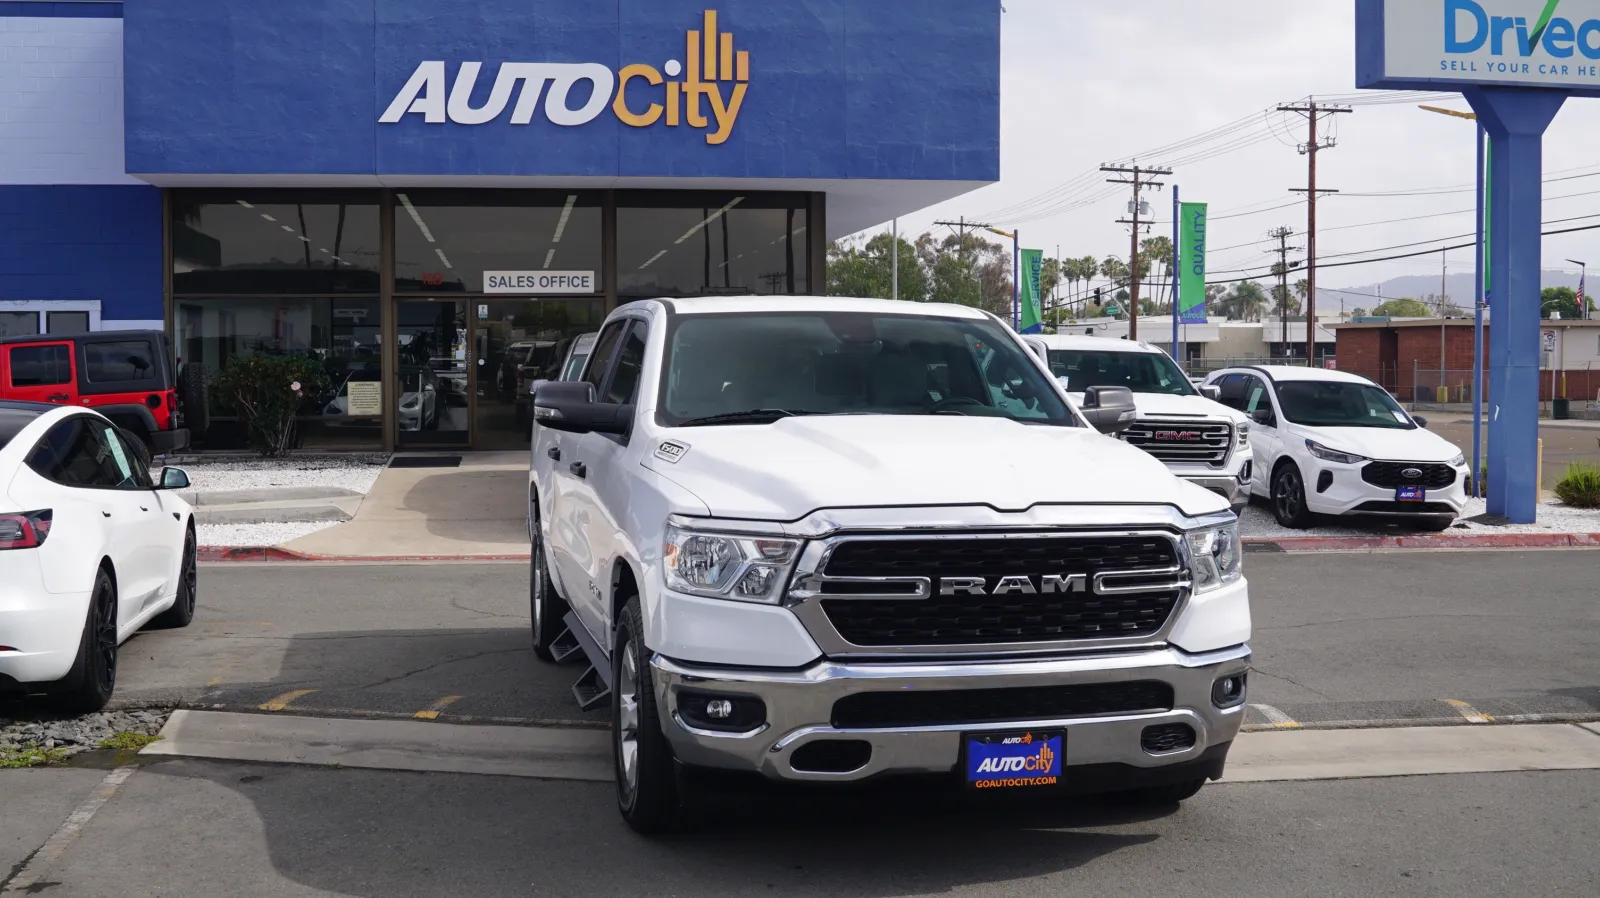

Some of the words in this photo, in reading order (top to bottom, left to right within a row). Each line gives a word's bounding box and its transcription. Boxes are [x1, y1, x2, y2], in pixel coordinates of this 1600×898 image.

[1440, 60, 1478, 72] SELL
[1486, 62, 1529, 74] YOUR
[1538, 64, 1569, 75] CAR
[1578, 66, 1600, 76] HE
[488, 275, 535, 288] SALES
[539, 275, 590, 288] OFFICE
[1155, 430, 1202, 441] GMC
[661, 443, 684, 457] 1500
[939, 573, 1087, 596] RAM
[976, 742, 1054, 774] AUTOCity
[975, 776, 1057, 788] GOAUTOCITY.COM
